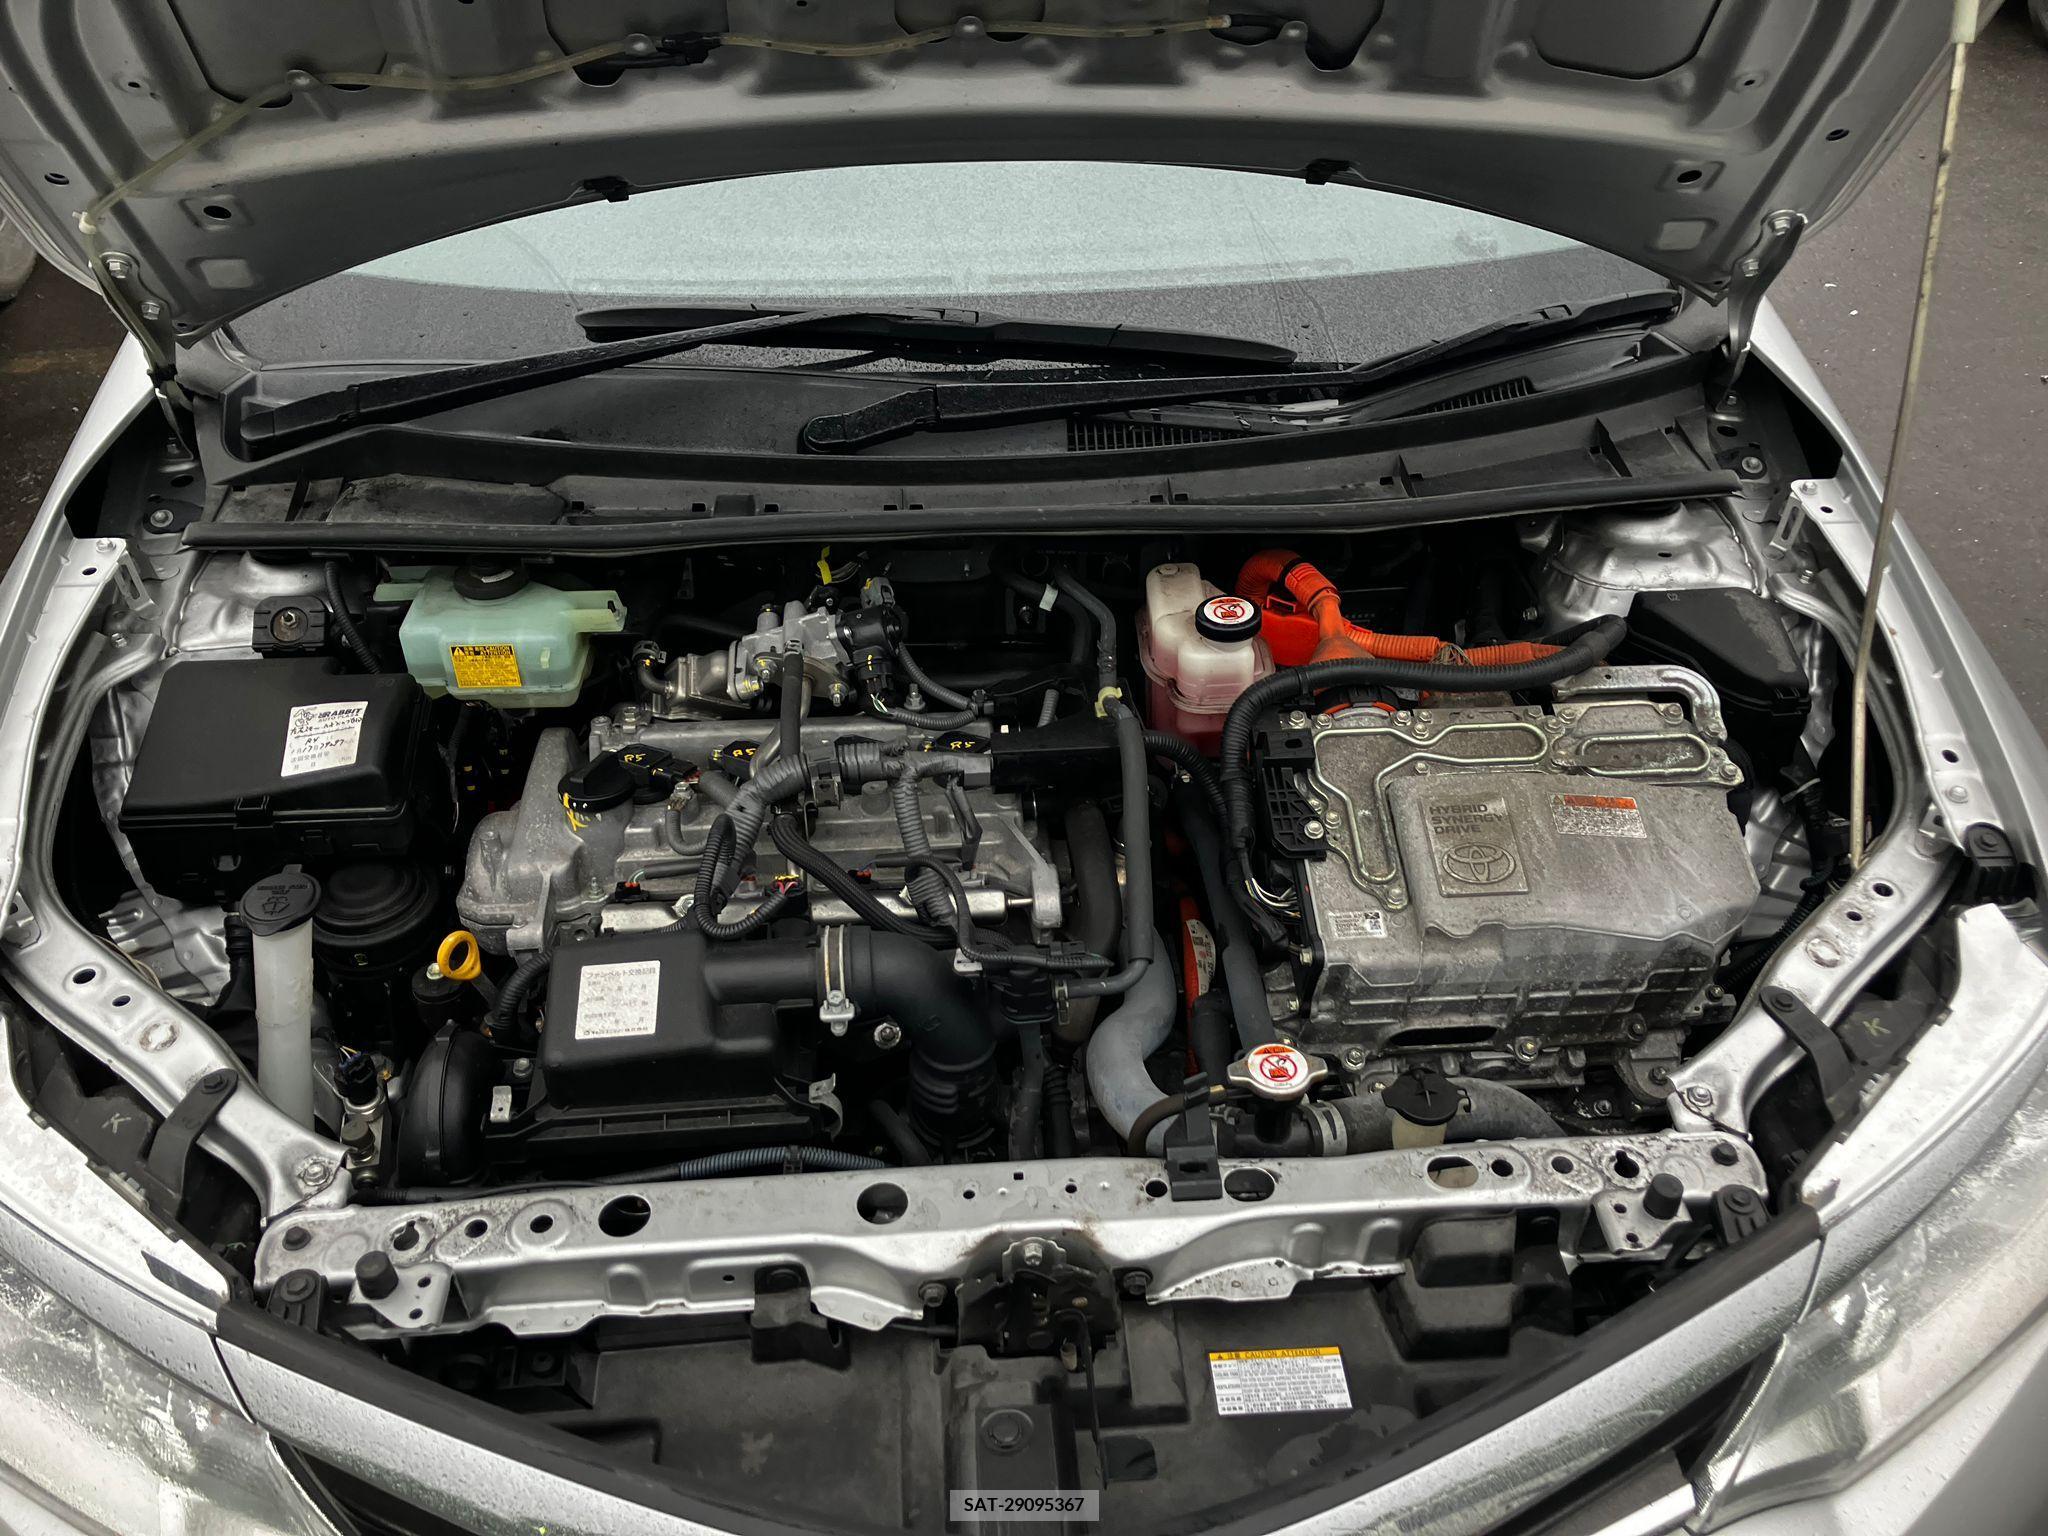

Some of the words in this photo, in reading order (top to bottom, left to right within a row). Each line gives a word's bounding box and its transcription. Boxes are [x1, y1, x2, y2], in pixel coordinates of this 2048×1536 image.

[1430, 804, 1488, 815] HYBRID
[1431, 813, 1503, 825] SYNERGY
[1434, 824, 1481, 834] DRIVE
[1245, 1350, 1277, 1359] CAUTION
[1281, 1348, 1321, 1358] ATTENTION
